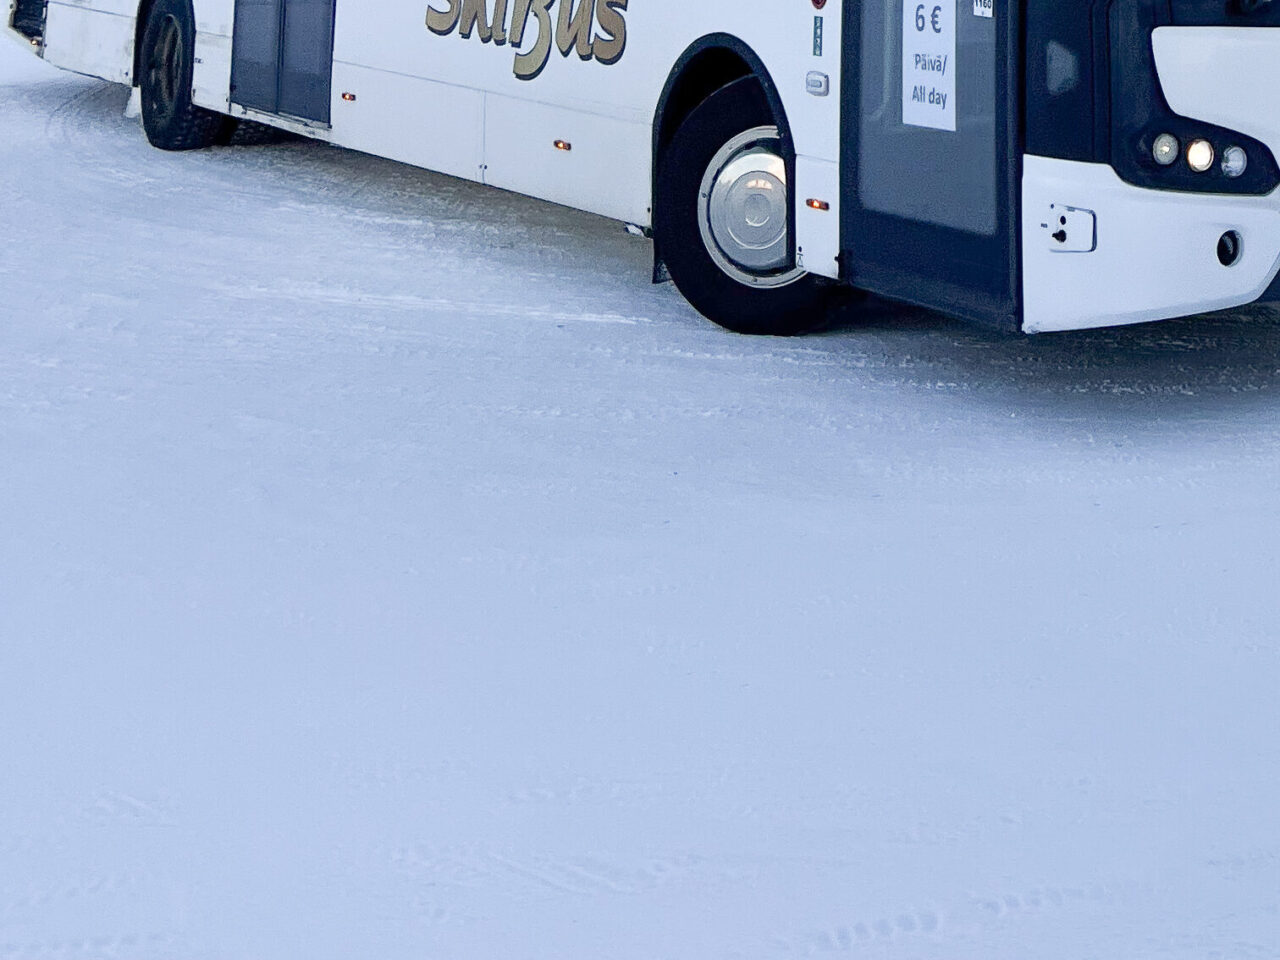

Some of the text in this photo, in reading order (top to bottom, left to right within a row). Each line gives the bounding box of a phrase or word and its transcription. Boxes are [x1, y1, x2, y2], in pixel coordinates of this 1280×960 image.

[915, 3, 926, 32] 6
[912, 85, 948, 110] All day
